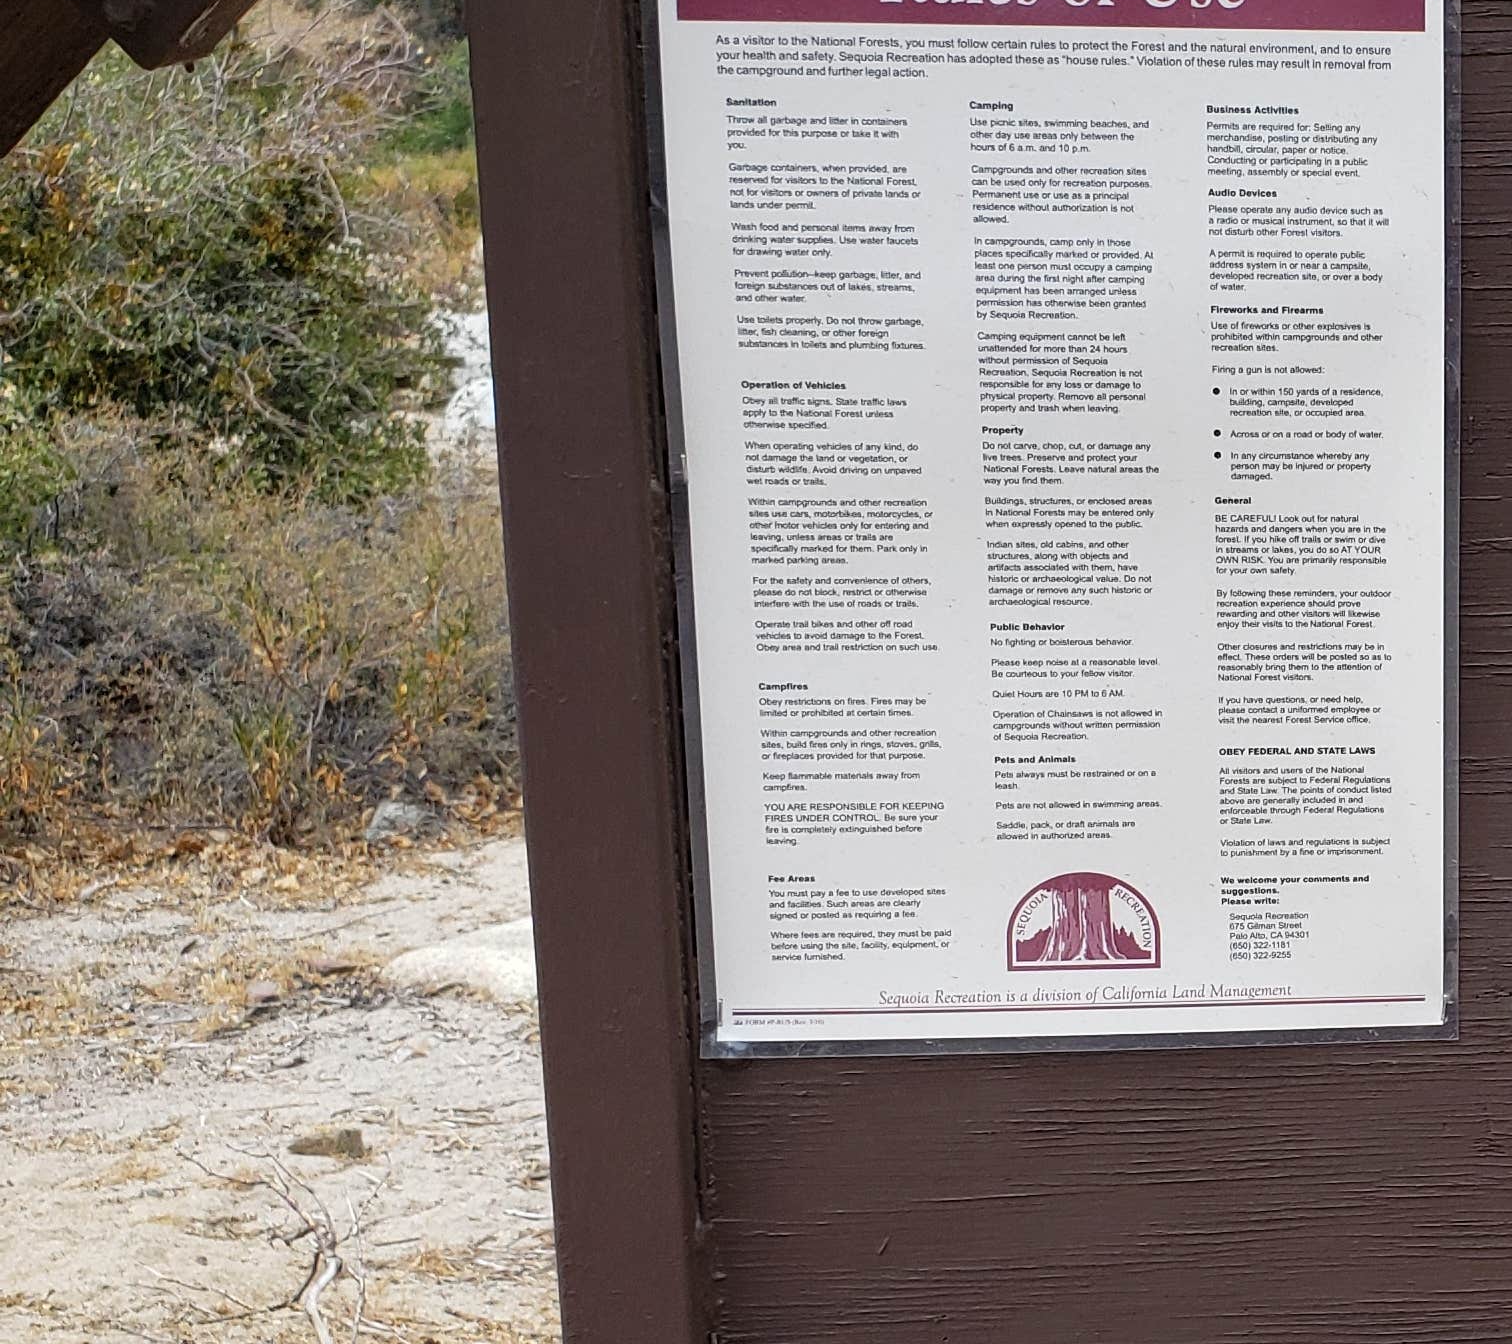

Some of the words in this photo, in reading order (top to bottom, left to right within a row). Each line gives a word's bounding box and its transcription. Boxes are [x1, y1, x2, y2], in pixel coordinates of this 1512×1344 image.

[714, 34, 731, 45] As
[731, 36, 740, 45] a
[741, 34, 775, 45] visitor
[777, 36, 789, 45] to
[790, 35, 808, 46] the
[809, 35, 856, 46] National
[858, 36, 903, 48] Forests,
[904, 39, 925, 50] you
[927, 38, 955, 48] must
[956, 37, 989, 49] follow
[990, 39, 1027, 49] certain
[1029, 39, 1057, 50] rules
[1058, 40, 1070, 50] to
[1071, 40, 1109, 52] protect
[1110, 40, 1128, 51] the
[1130, 40, 1165, 51] Forest
[1167, 41, 1188, 52] and
[1189, 42, 1207, 52] the
[1209, 42, 1246, 53] natural
[1248, 42, 1317, 55] environment,
[1319, 43, 1340, 54] and
[1341, 44, 1353, 54] to
[1354, 46, 1391, 55] ensure
[715, 64, 734, 75] the
[735, 65, 804, 78] campground
[805, 66, 826, 76] and
[826, 65, 864, 76] further
[864, 66, 891, 79] legal
[891, 66, 929, 77] action.
[725, 97, 777, 106] Sanitation
[968, 100, 1014, 112] Camping
[1205, 104, 1252, 114] Business
[1253, 105, 1299, 114] Activities
[1207, 188, 1237, 197] Audio
[1238, 188, 1277, 197] Devices
[1209, 305, 1259, 313] Fireworks
[1260, 305, 1279, 314] and
[1280, 305, 1324, 314] Firearms
[740, 380, 790, 390] Operation
[791, 381, 803, 389] of
[804, 380, 847, 389] Vehicles
[981, 424, 1024, 436] Property
[1213, 495, 1252, 505] General
[1021, 622, 1065, 630] Behavior
[757, 682, 809, 692] Campfires
[1218, 747, 1246, 755] OBEY
[1247, 747, 1292, 755] FEDERAL
[1293, 747, 1315, 755] AND
[1316, 746, 1347, 754] STATE
[1348, 746, 1376, 754] LAWS
[1017, 755, 1036, 763] and
[1037, 755, 1076, 763] Animals
[767, 874, 785, 882] Fee
[787, 874, 816, 882] Areas
[1016, 892, 1049, 936] SEQUOIA
[1113, 887, 1152, 948] RECREATION
[1228, 912, 1263, 922] Sequoia
[1264, 911, 1309, 920] Recreation
[1228, 932, 1249, 940] Palo
[1248, 931, 1268, 940] Alto,
[1269, 931, 1283, 939] CA
[878, 989, 929, 1005] Sequoia
[934, 988, 1002, 1002] Recreation
[1005, 989, 1016, 1001] is
[1019, 992, 1028, 1001] a
[1031, 986, 1081, 1001] division
[1084, 986, 1100, 1002] of
[1101, 984, 1167, 1000] California
[1171, 983, 1206, 998] Land
[1209, 982, 1292, 1000] Management
